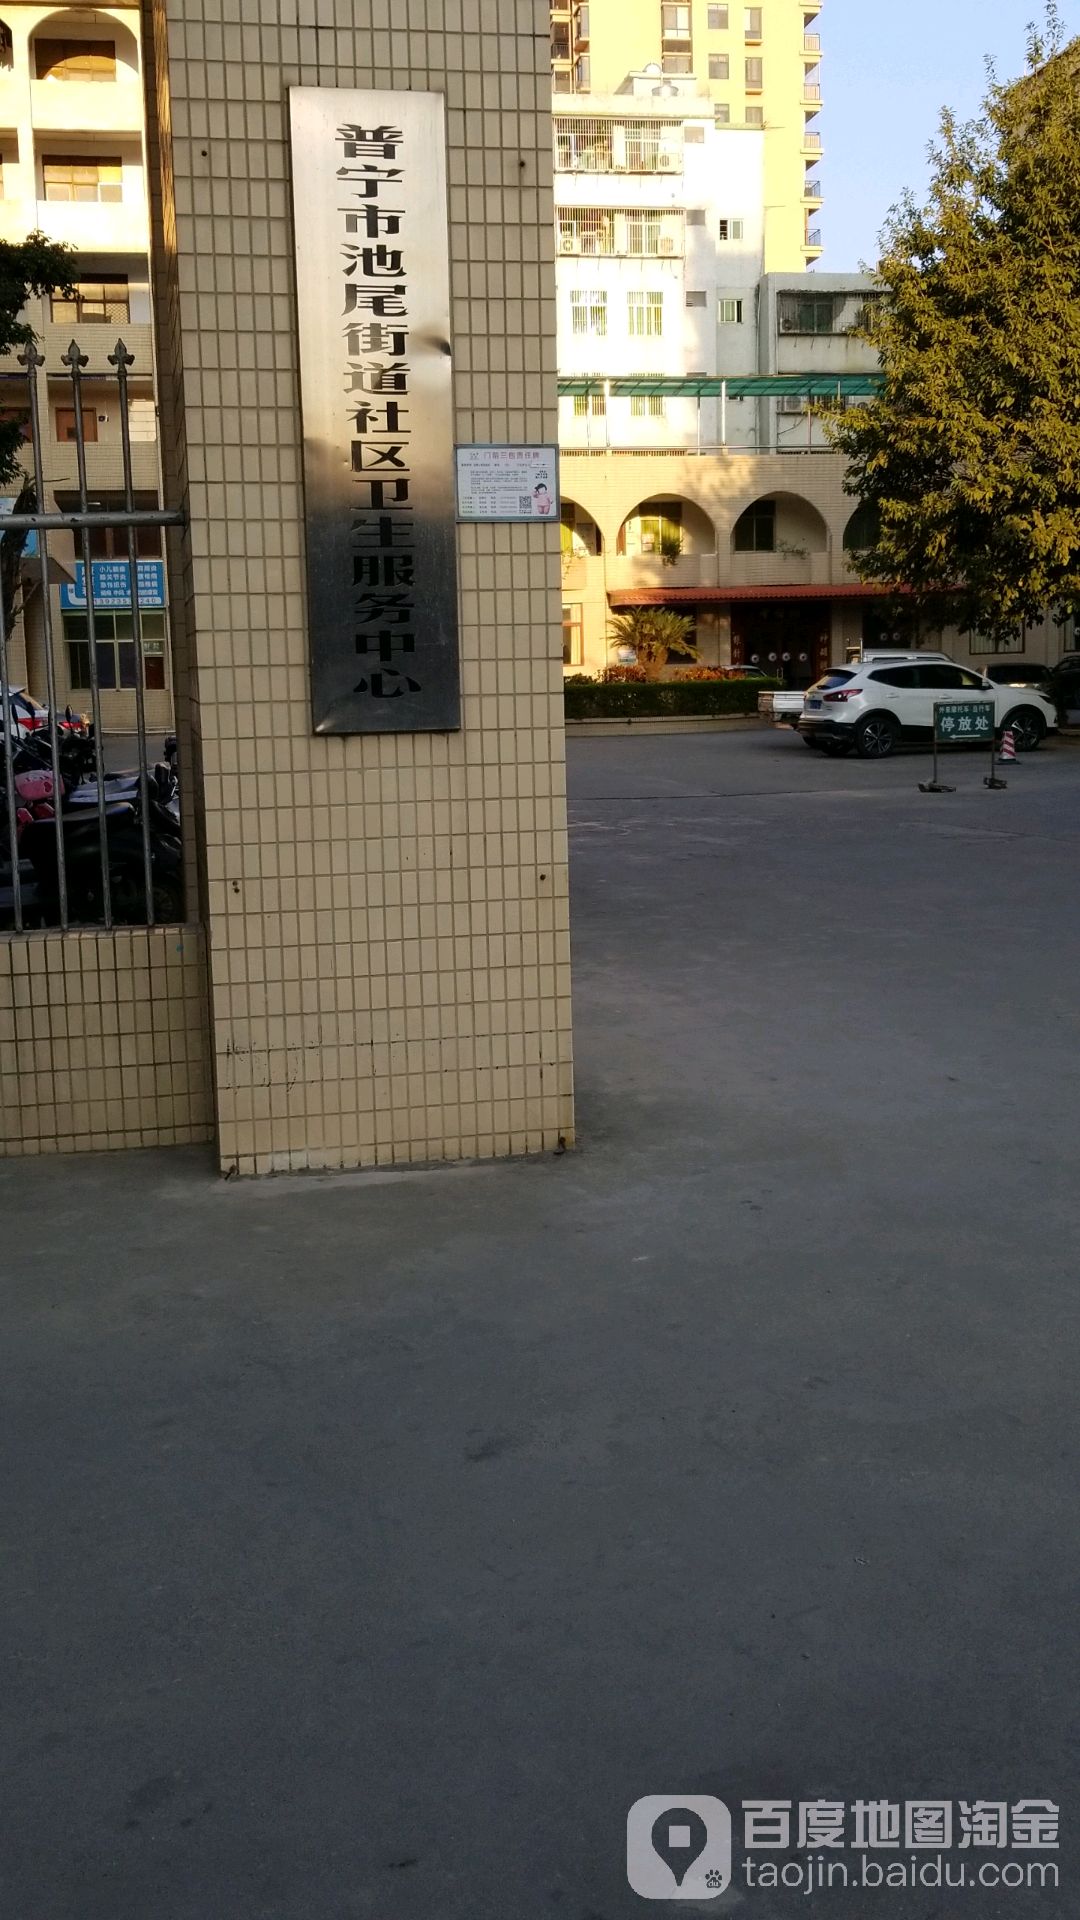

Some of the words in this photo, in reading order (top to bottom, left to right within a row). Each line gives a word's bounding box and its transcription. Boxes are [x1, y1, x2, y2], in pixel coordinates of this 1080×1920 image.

[335, 124, 421, 699] 普宁市池尾街道社区卫生服务中心
[940, 716, 989, 732] 停放处
